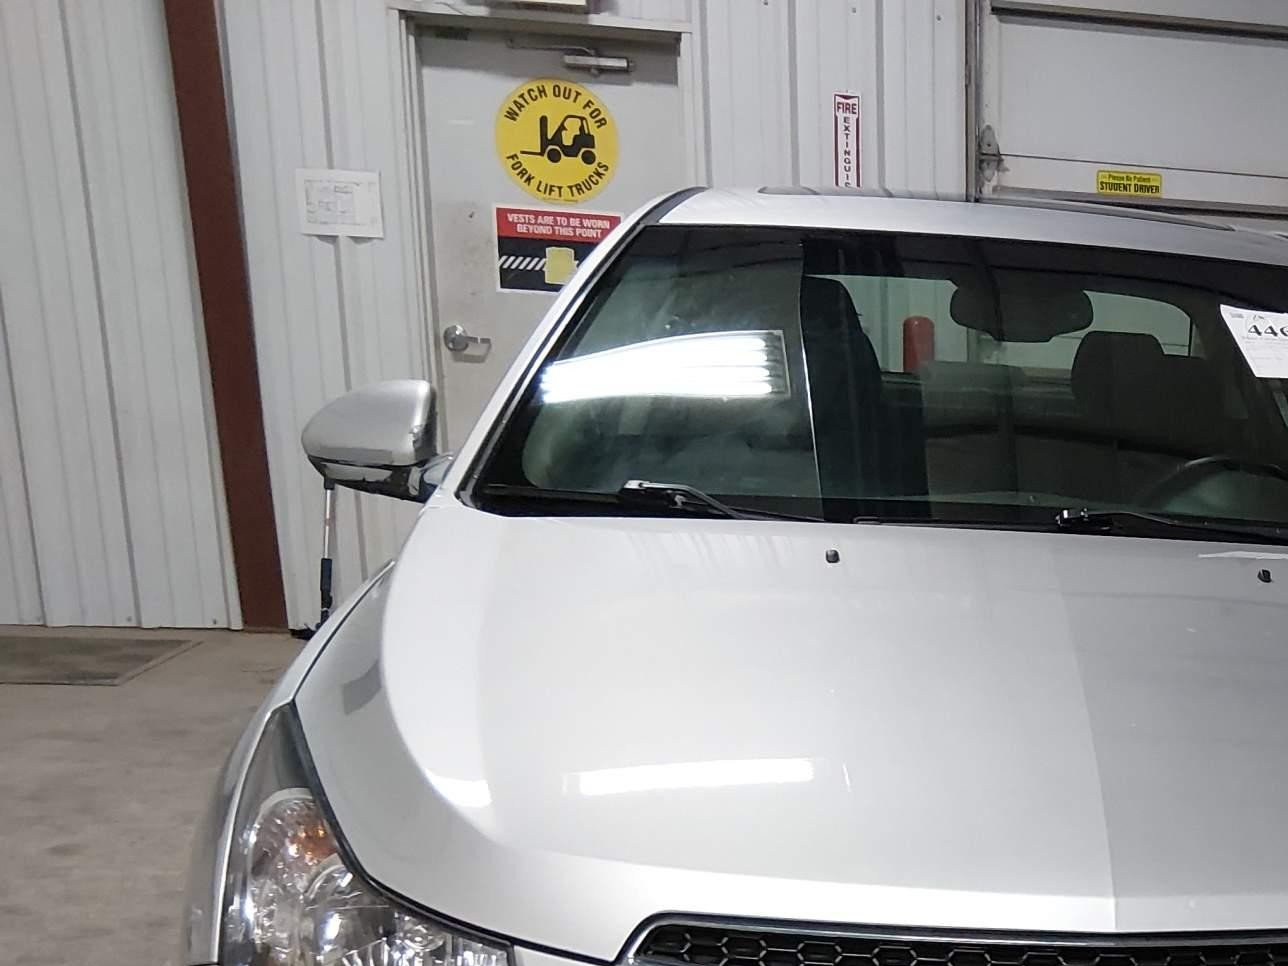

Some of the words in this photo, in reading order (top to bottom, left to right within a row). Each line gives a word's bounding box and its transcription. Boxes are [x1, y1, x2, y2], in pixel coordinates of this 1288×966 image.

[504, 85, 548, 122] WATCH
[552, 84, 582, 103] OUT
[582, 99, 608, 129] FOR
[836, 102, 857, 114] FIRE
[506, 153, 535, 186] FORK
[536, 180, 563, 198] LIFT
[567, 161, 609, 198] TRUCKS
[1100, 181, 1132, 192] STUDENT
[1133, 183, 1160, 194] DRIVER
[507, 213, 535, 223] VESTS
[537, 215, 554, 225] ARE
[557, 217, 567, 226] TO
[570, 217, 580, 226] BE
[582, 218, 610, 229] WORN
[516, 224, 552, 234] BEYOND
[554, 226, 574, 236] THIS
[576, 228, 602, 238] POINT
